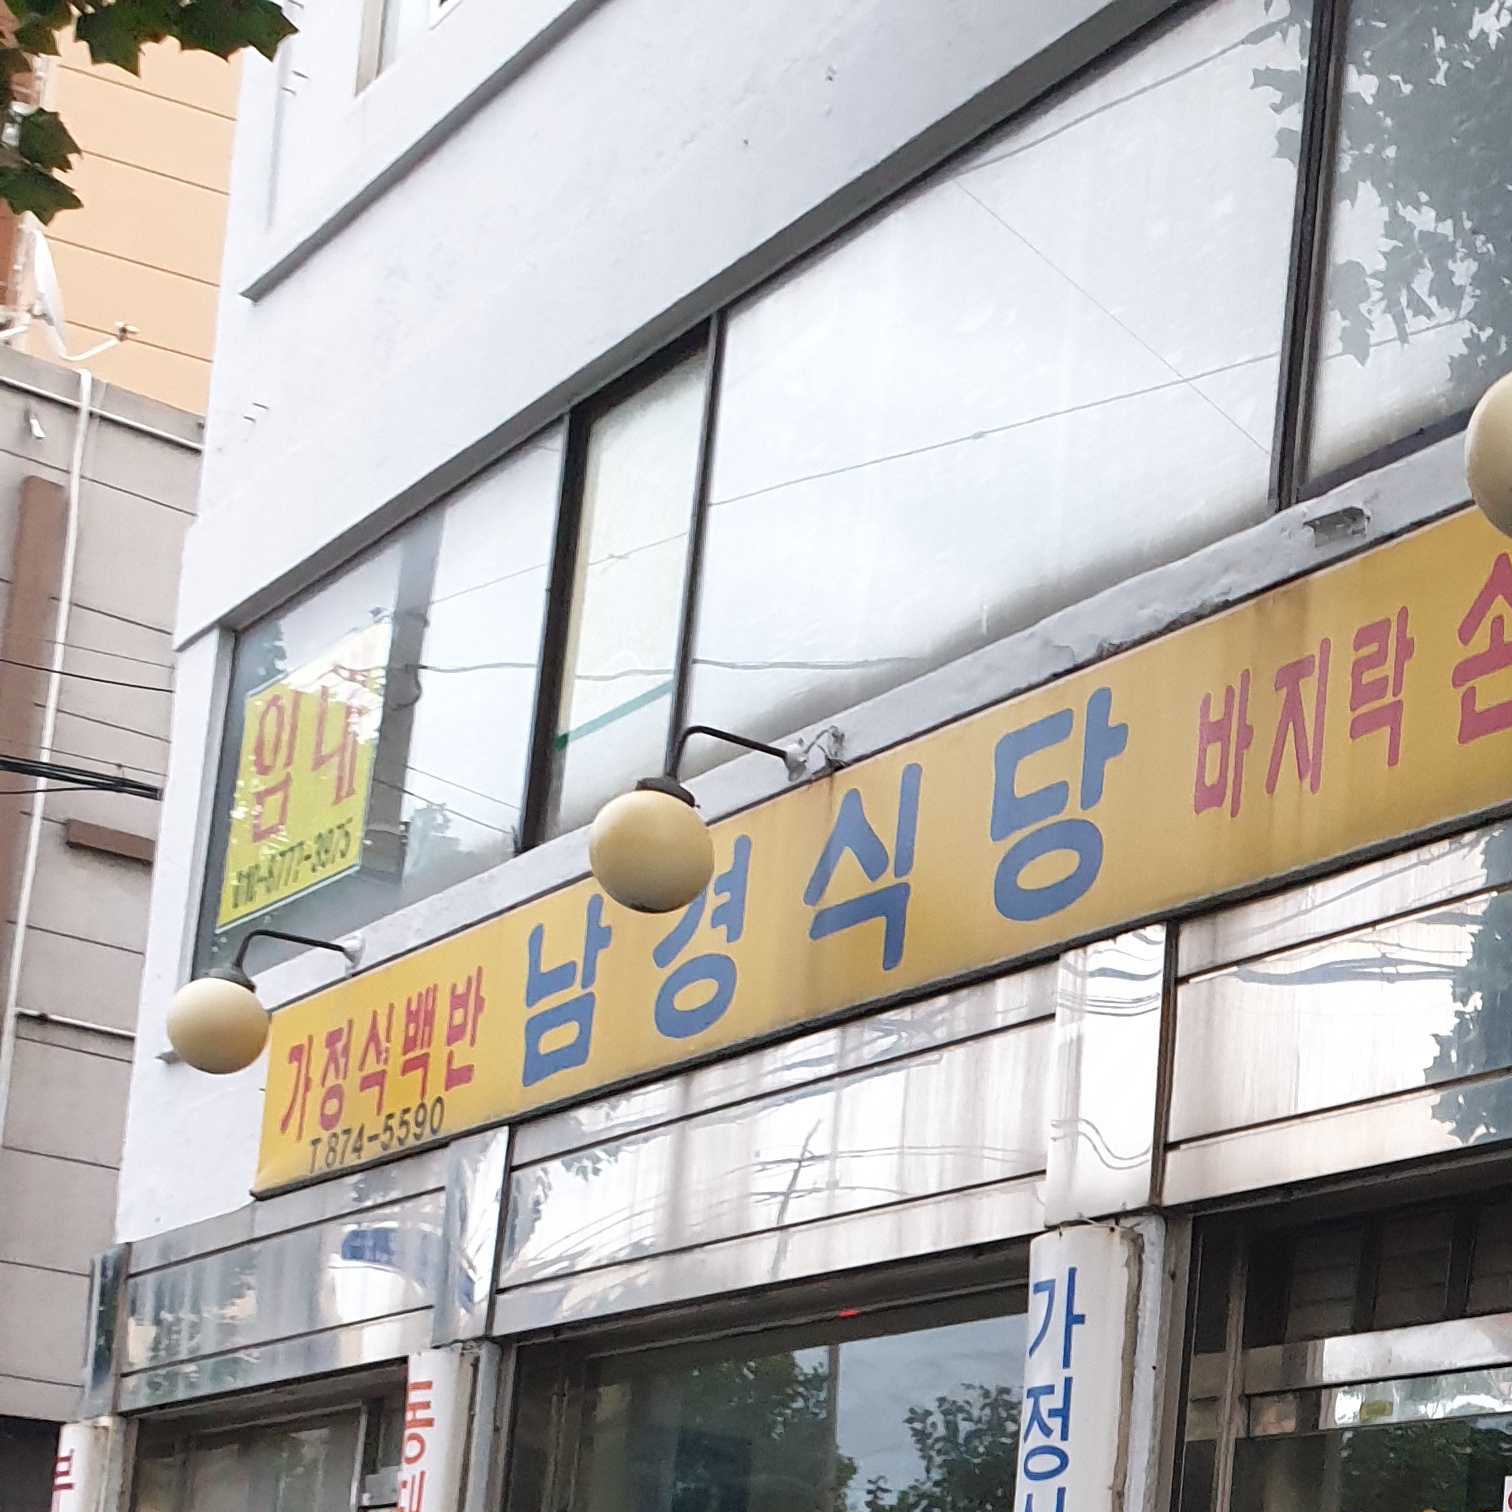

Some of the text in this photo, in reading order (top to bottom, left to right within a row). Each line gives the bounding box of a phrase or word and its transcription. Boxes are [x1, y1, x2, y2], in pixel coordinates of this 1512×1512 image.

[1194, 606, 1414, 818] 바지락
[522, 686, 1129, 1088] 남경식당
[281, 965, 486, 1143] 가정식백반
